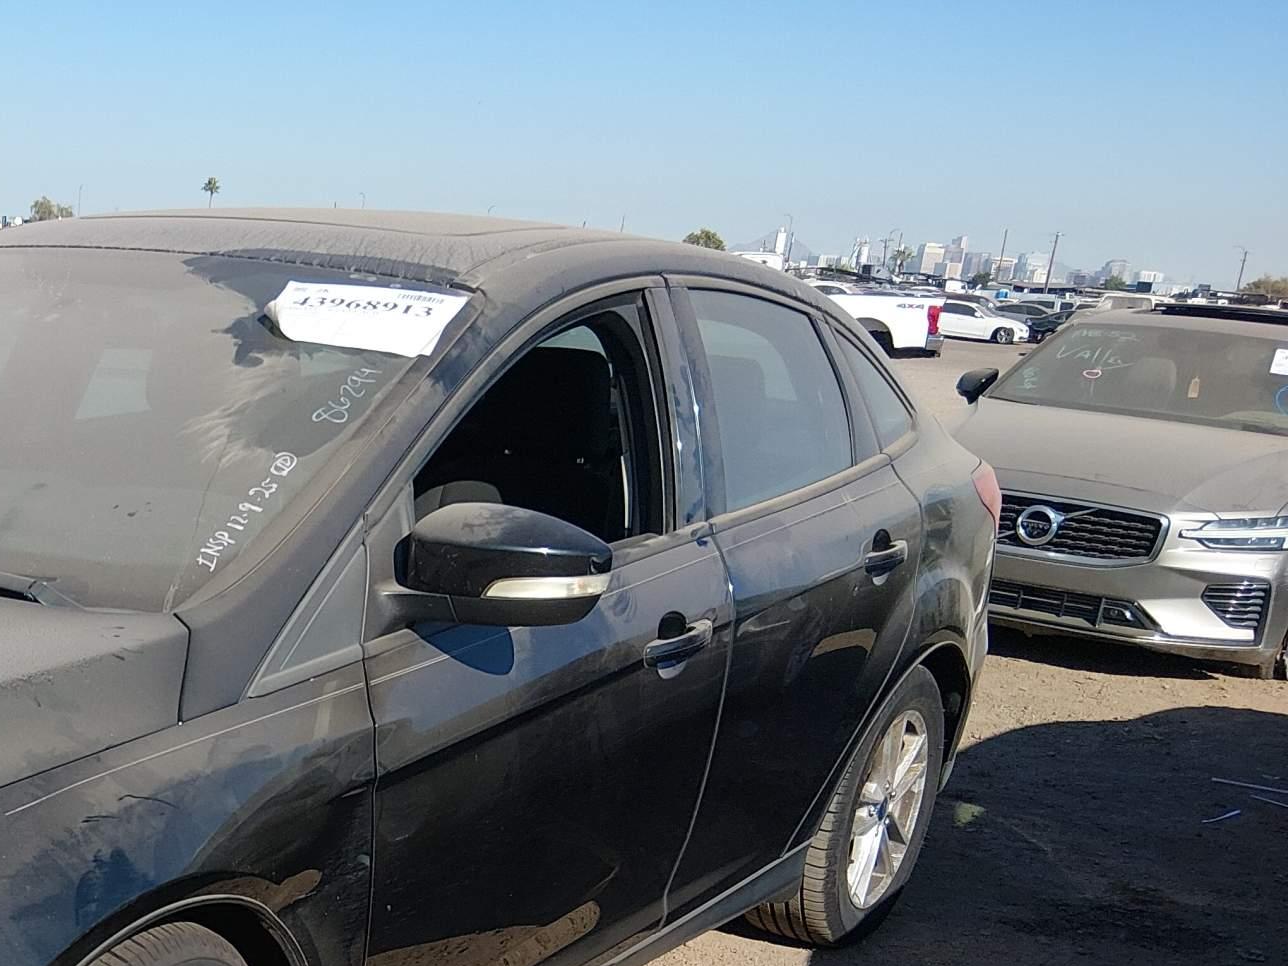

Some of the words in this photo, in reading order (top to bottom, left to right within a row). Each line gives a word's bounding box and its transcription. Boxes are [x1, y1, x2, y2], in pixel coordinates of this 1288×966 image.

[293, 296, 434, 318] 43968913
[312, 367, 383, 423] 86294
[196, 530, 236, 573] INSP
